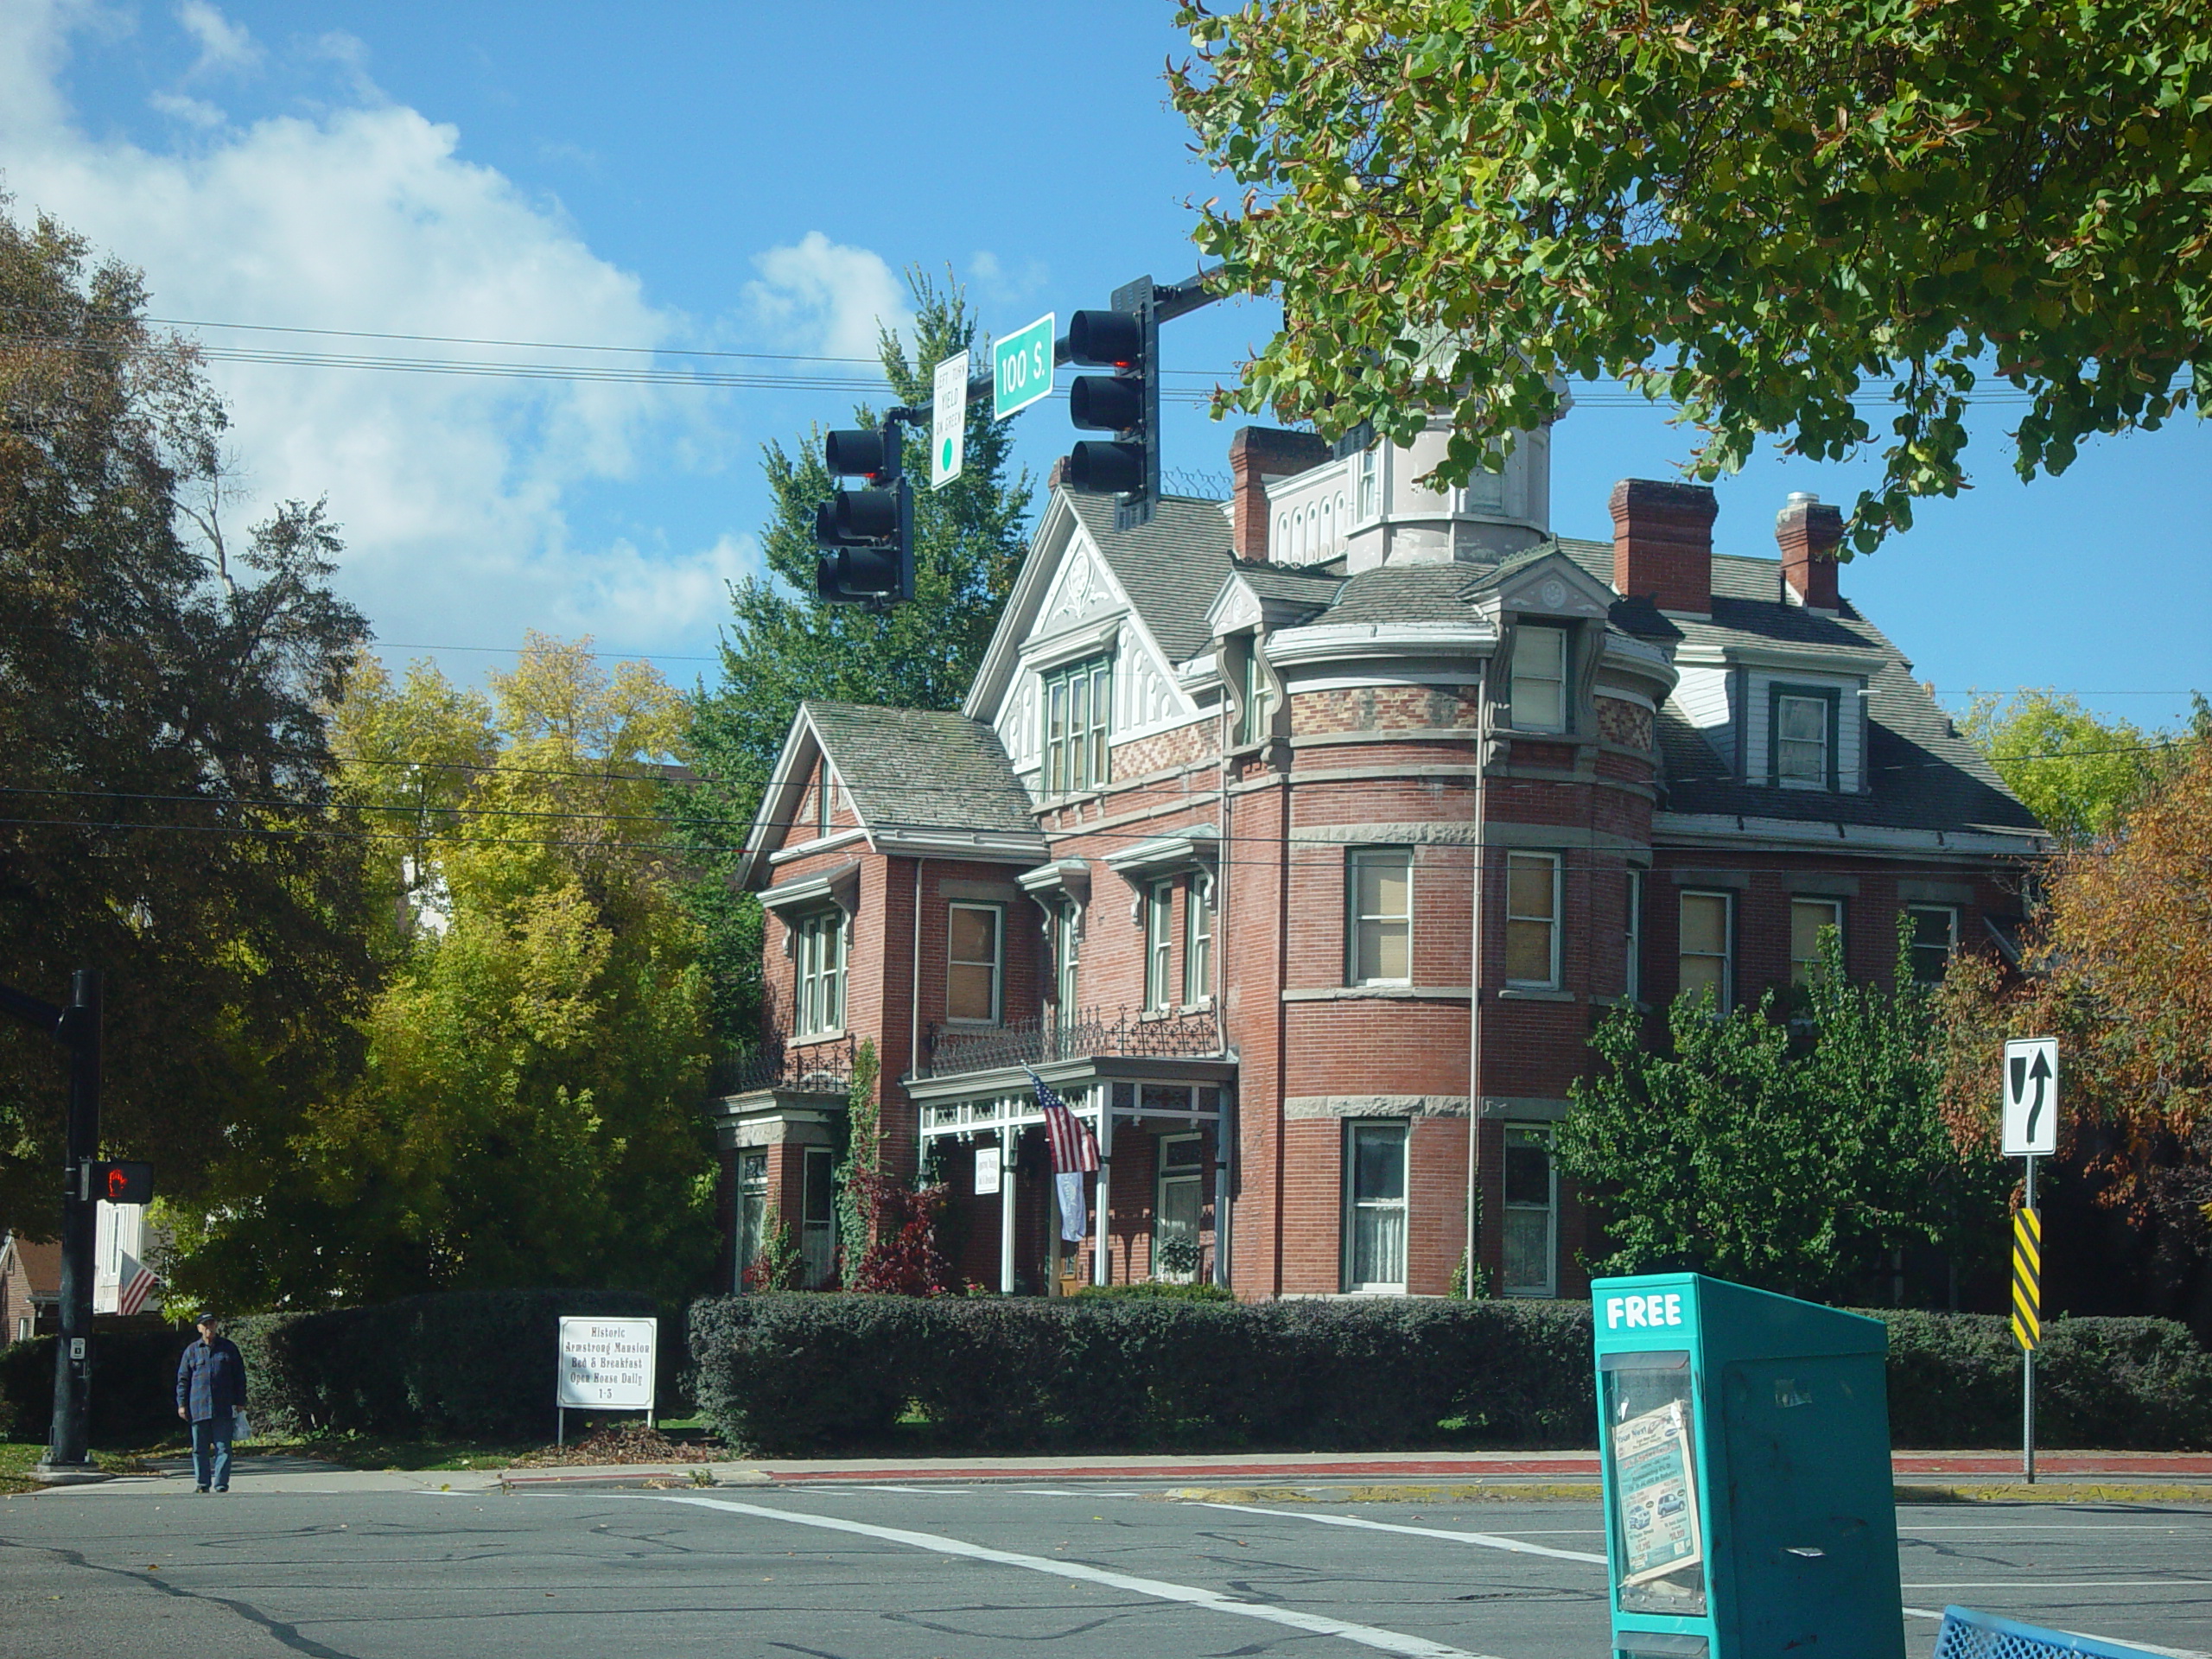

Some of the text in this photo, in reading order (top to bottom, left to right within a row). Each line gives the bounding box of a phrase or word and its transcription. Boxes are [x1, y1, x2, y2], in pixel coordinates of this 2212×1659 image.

[1002, 340, 1045, 396] 100 S.
[942, 387, 959, 412] YIELD
[945, 411, 962, 431] GREEN
[1607, 1294, 1681, 1329] FREE
[591, 1326, 626, 1338] Historic
[566, 1342, 650, 1356] Armstrong Mansion
[571, 1357, 642, 1368] Bed & Breakfast
[570, 1372, 643, 1386] Open House Daily
